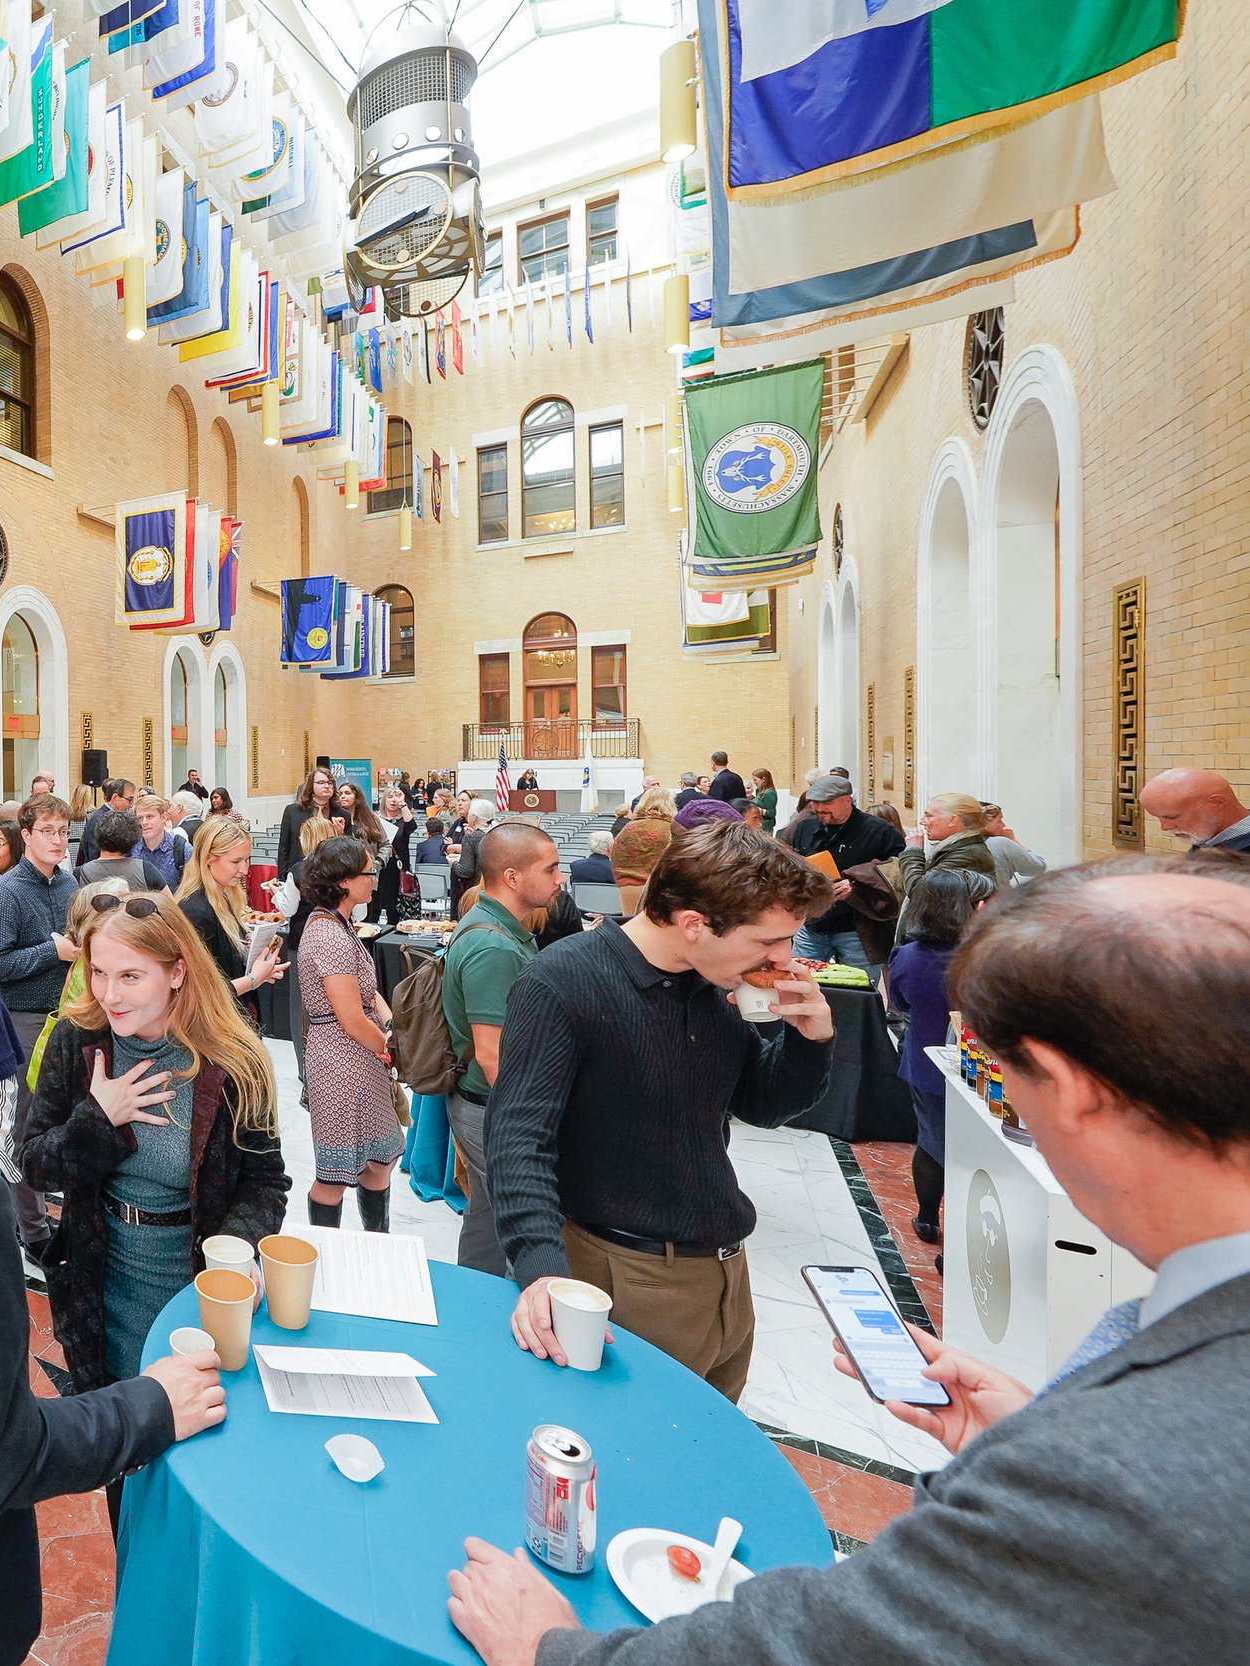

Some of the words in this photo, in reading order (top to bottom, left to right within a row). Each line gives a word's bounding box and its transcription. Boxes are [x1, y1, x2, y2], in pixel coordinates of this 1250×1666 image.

[193, 15, 202, 38] ROWE
[715, 432, 741, 454] TOWN
[776, 428, 807, 476] DARTMOUTH
[716, 486, 796, 511] MASSACHUSETTS
